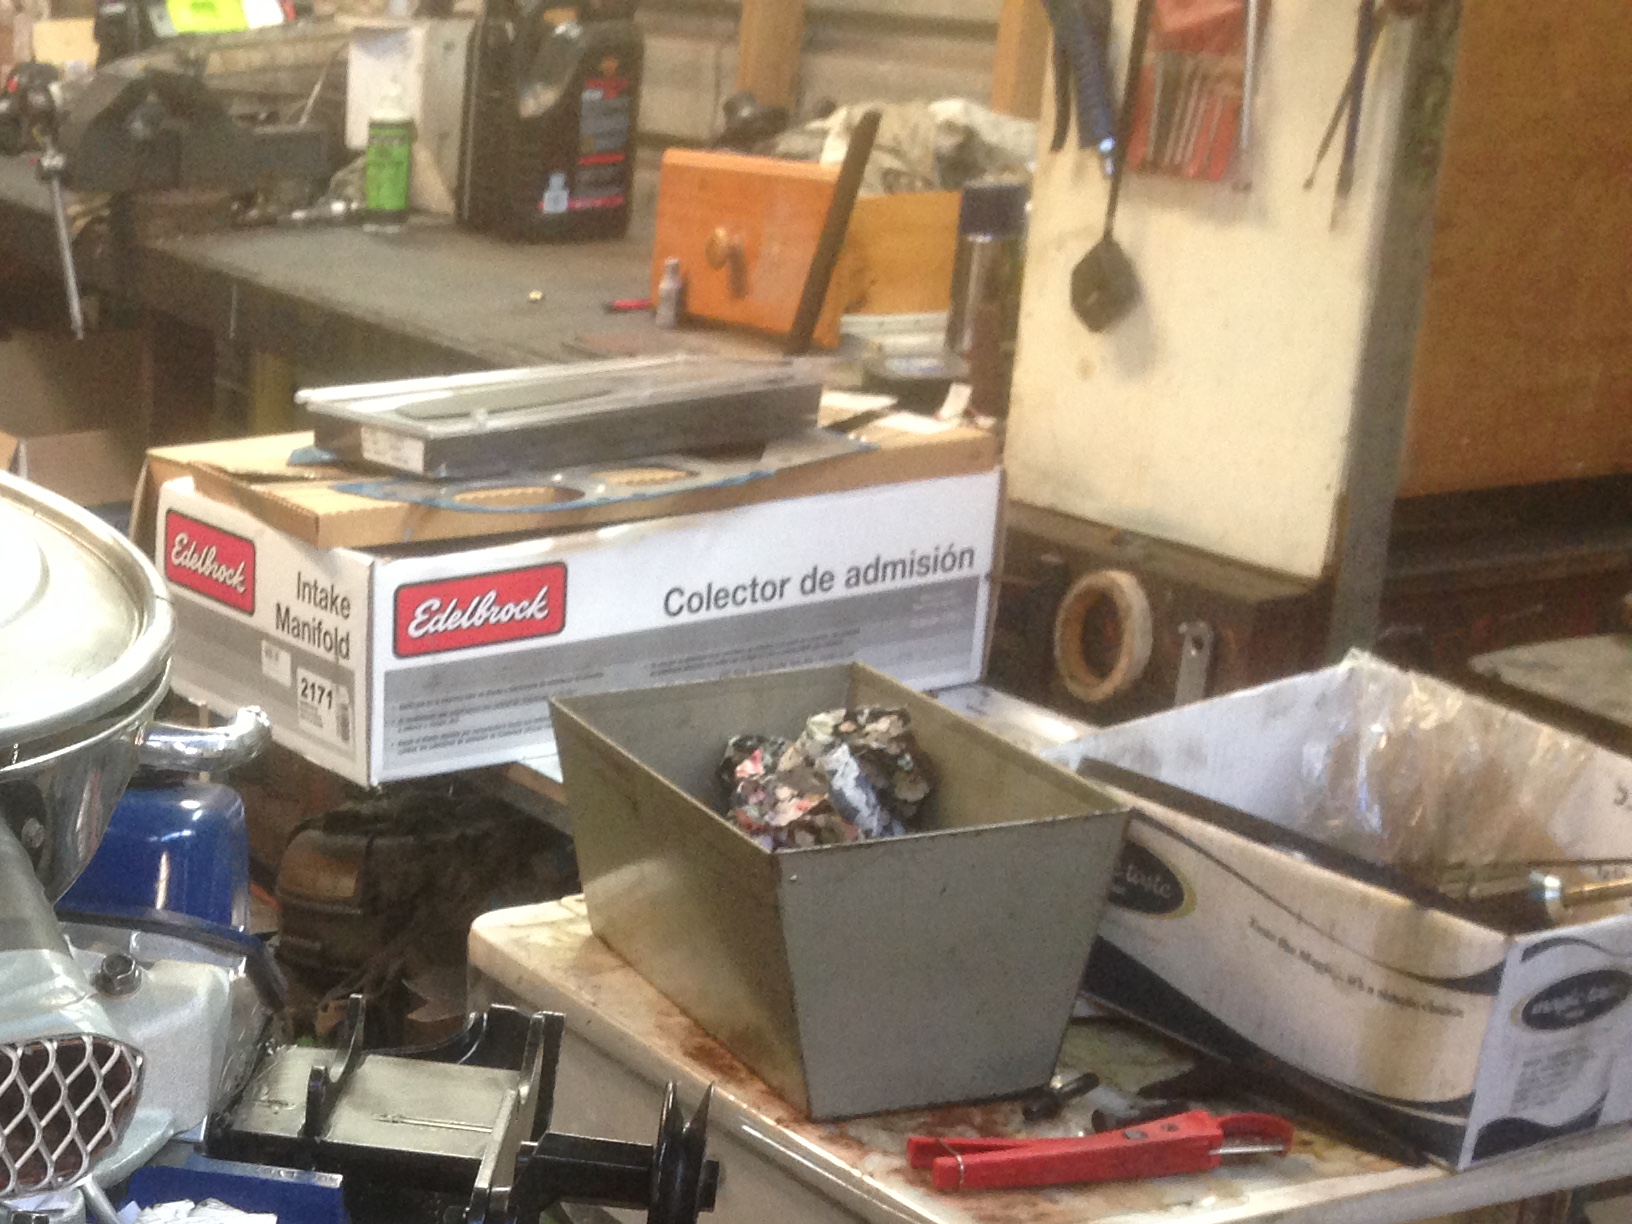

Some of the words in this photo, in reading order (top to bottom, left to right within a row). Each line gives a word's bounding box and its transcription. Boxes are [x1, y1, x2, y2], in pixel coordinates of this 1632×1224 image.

[170, 531, 247, 595] Edelbrock
[663, 575, 791, 618] Colector
[800, 565, 836, 596] de
[844, 543, 976, 590] admisión
[296, 570, 351, 620] Intake
[407, 585, 550, 639] Edelbrock
[275, 602, 351, 661] Manifold
[300, 677, 334, 710] 2171
